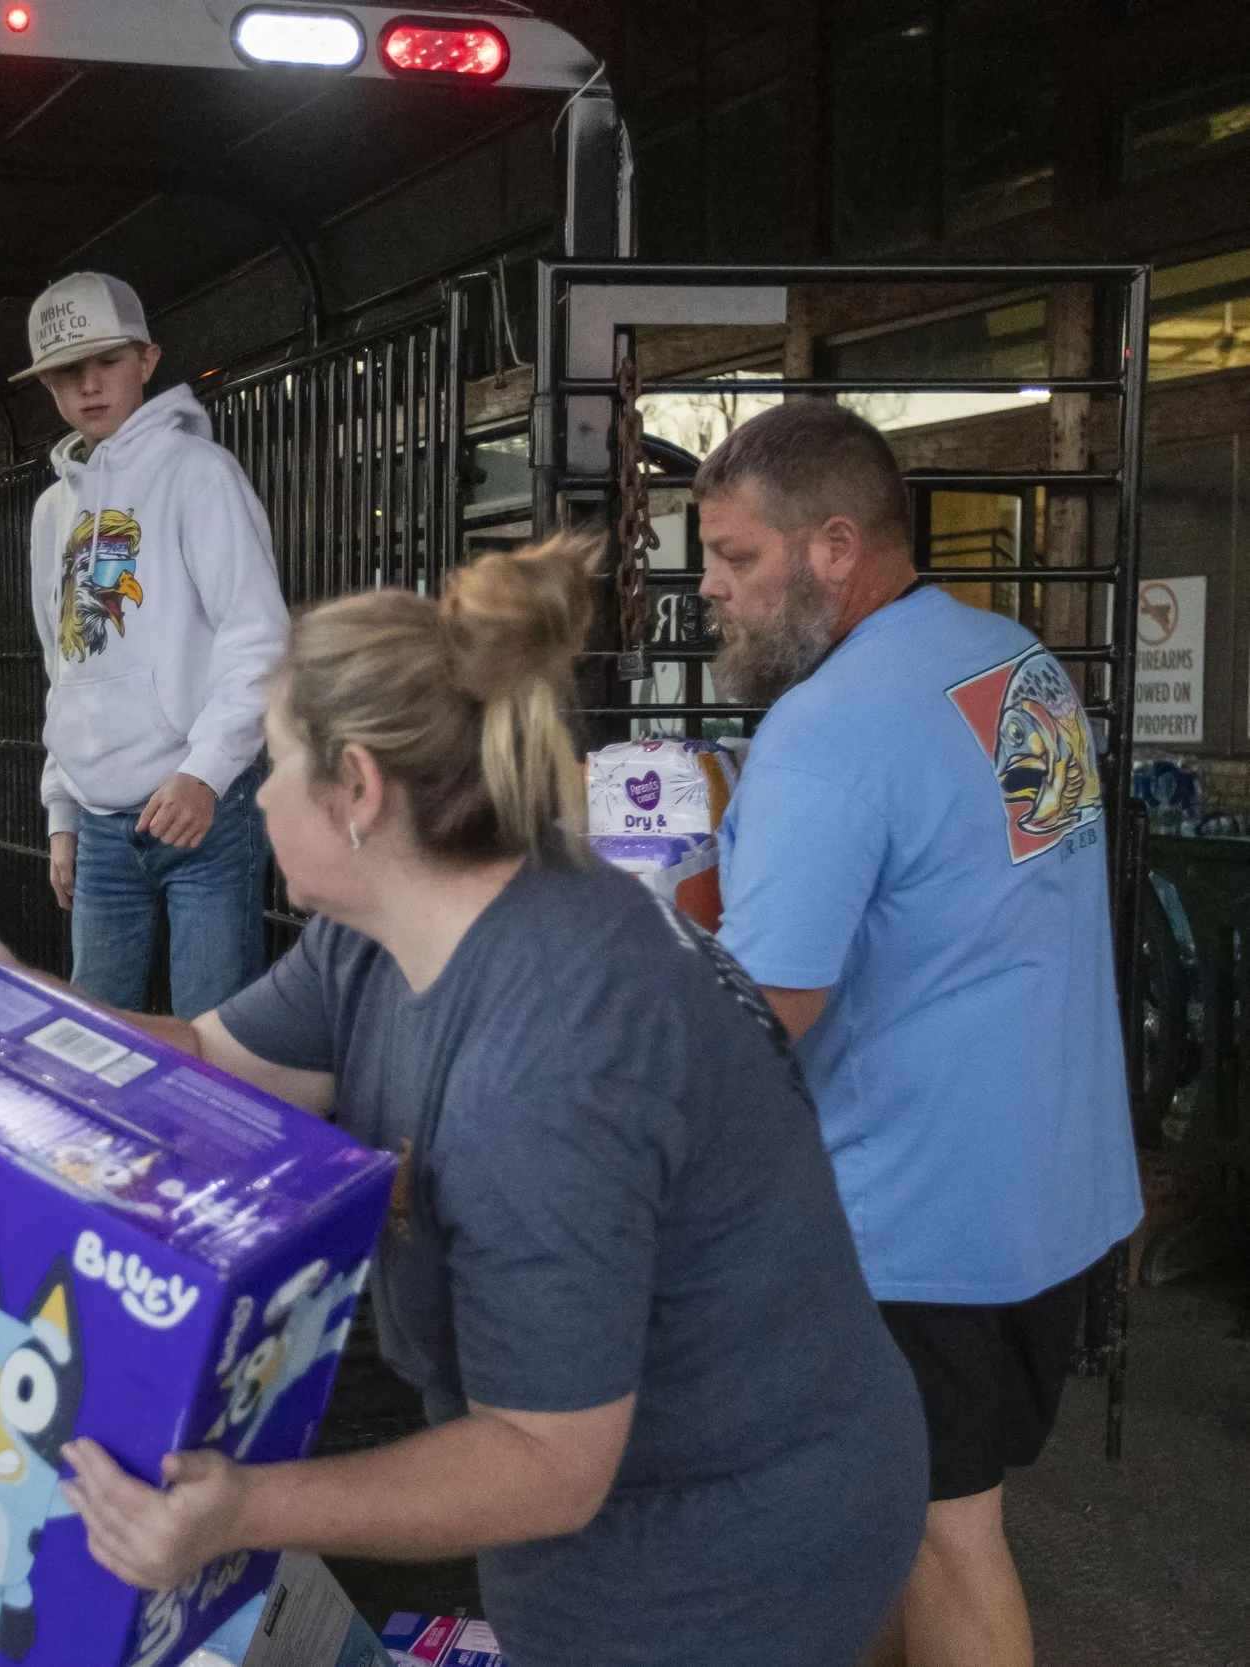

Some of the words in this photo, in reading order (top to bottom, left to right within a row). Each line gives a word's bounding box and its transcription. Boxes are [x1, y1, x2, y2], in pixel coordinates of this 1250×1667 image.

[40, 301, 75, 325] WBHC
[35, 320, 66, 343] CATTLE
[70, 315, 91, 328] CO.
[1173, 681, 1191, 701] ON
[1136, 714, 1198, 736] PROPERTY
[625, 814, 652, 831] Dry
[656, 814, 668, 827] &
